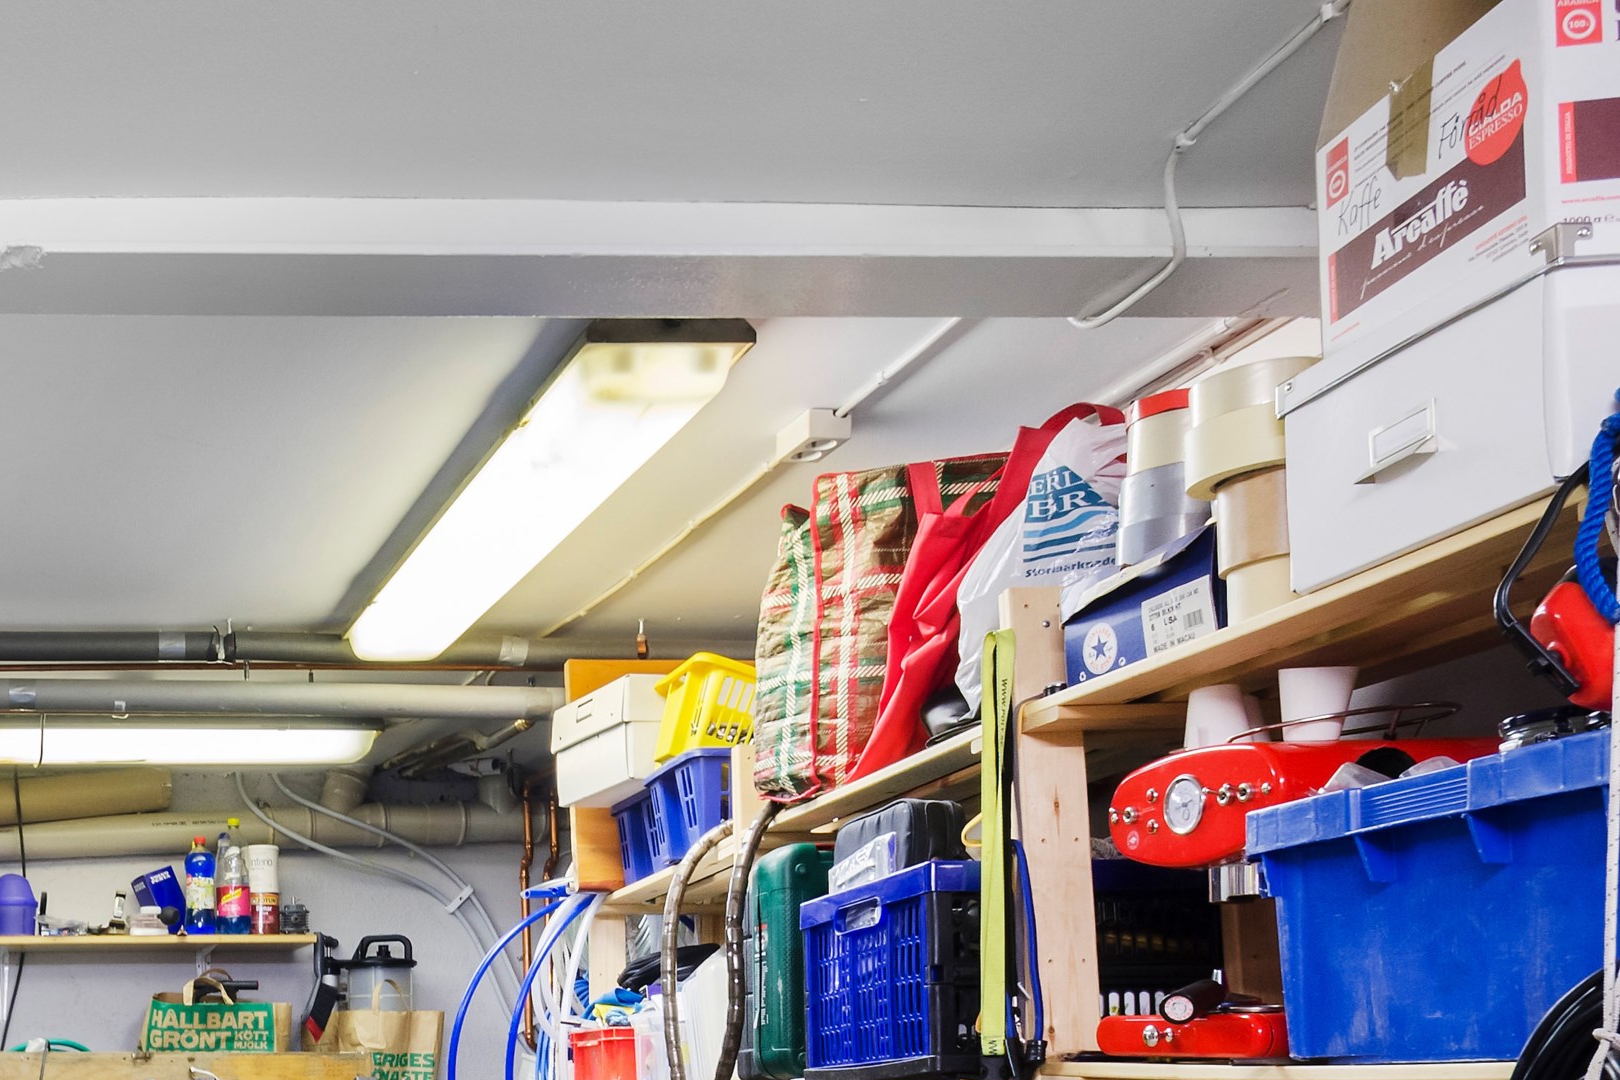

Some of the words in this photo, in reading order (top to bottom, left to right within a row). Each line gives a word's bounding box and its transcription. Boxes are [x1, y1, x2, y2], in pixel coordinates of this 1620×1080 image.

[1469, 103, 1523, 150] ESPRESSO
[149, 1028, 232, 1049] GRÖNT
[372, 1051, 435, 1068] ERIGES
